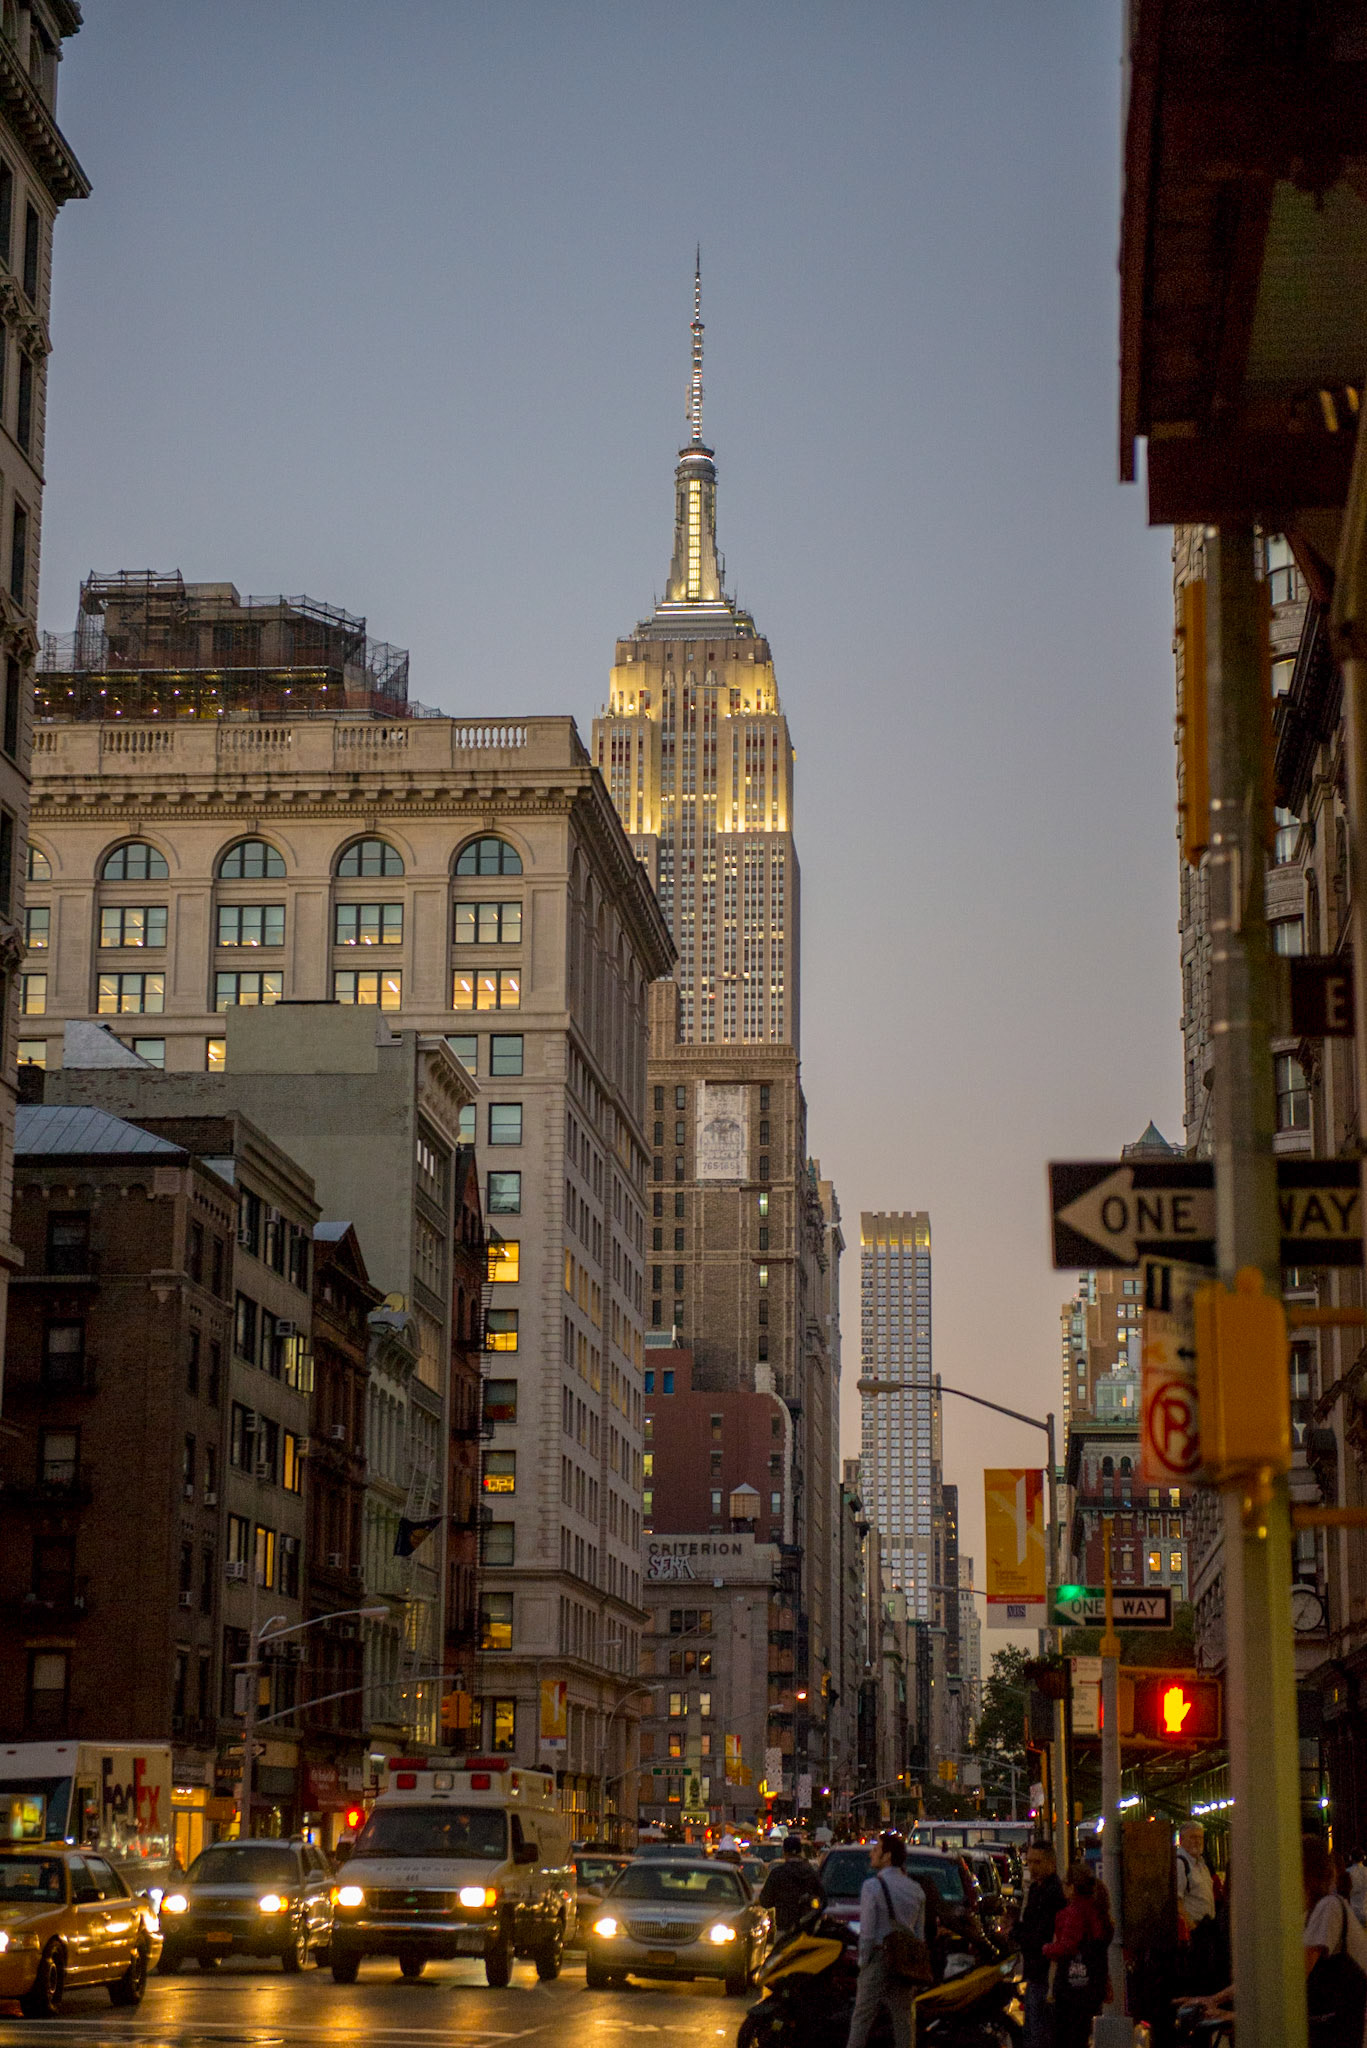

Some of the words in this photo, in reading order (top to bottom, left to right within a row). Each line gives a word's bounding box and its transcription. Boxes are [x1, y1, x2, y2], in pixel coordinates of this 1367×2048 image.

[1100, 1194, 1197, 1234] ONE
[648, 1542, 743, 1556] CRITERION
[1071, 1599, 1105, 1615] ONE
[1122, 1599, 1158, 1615] WAY
[102, 1757, 161, 1834] FedEx
